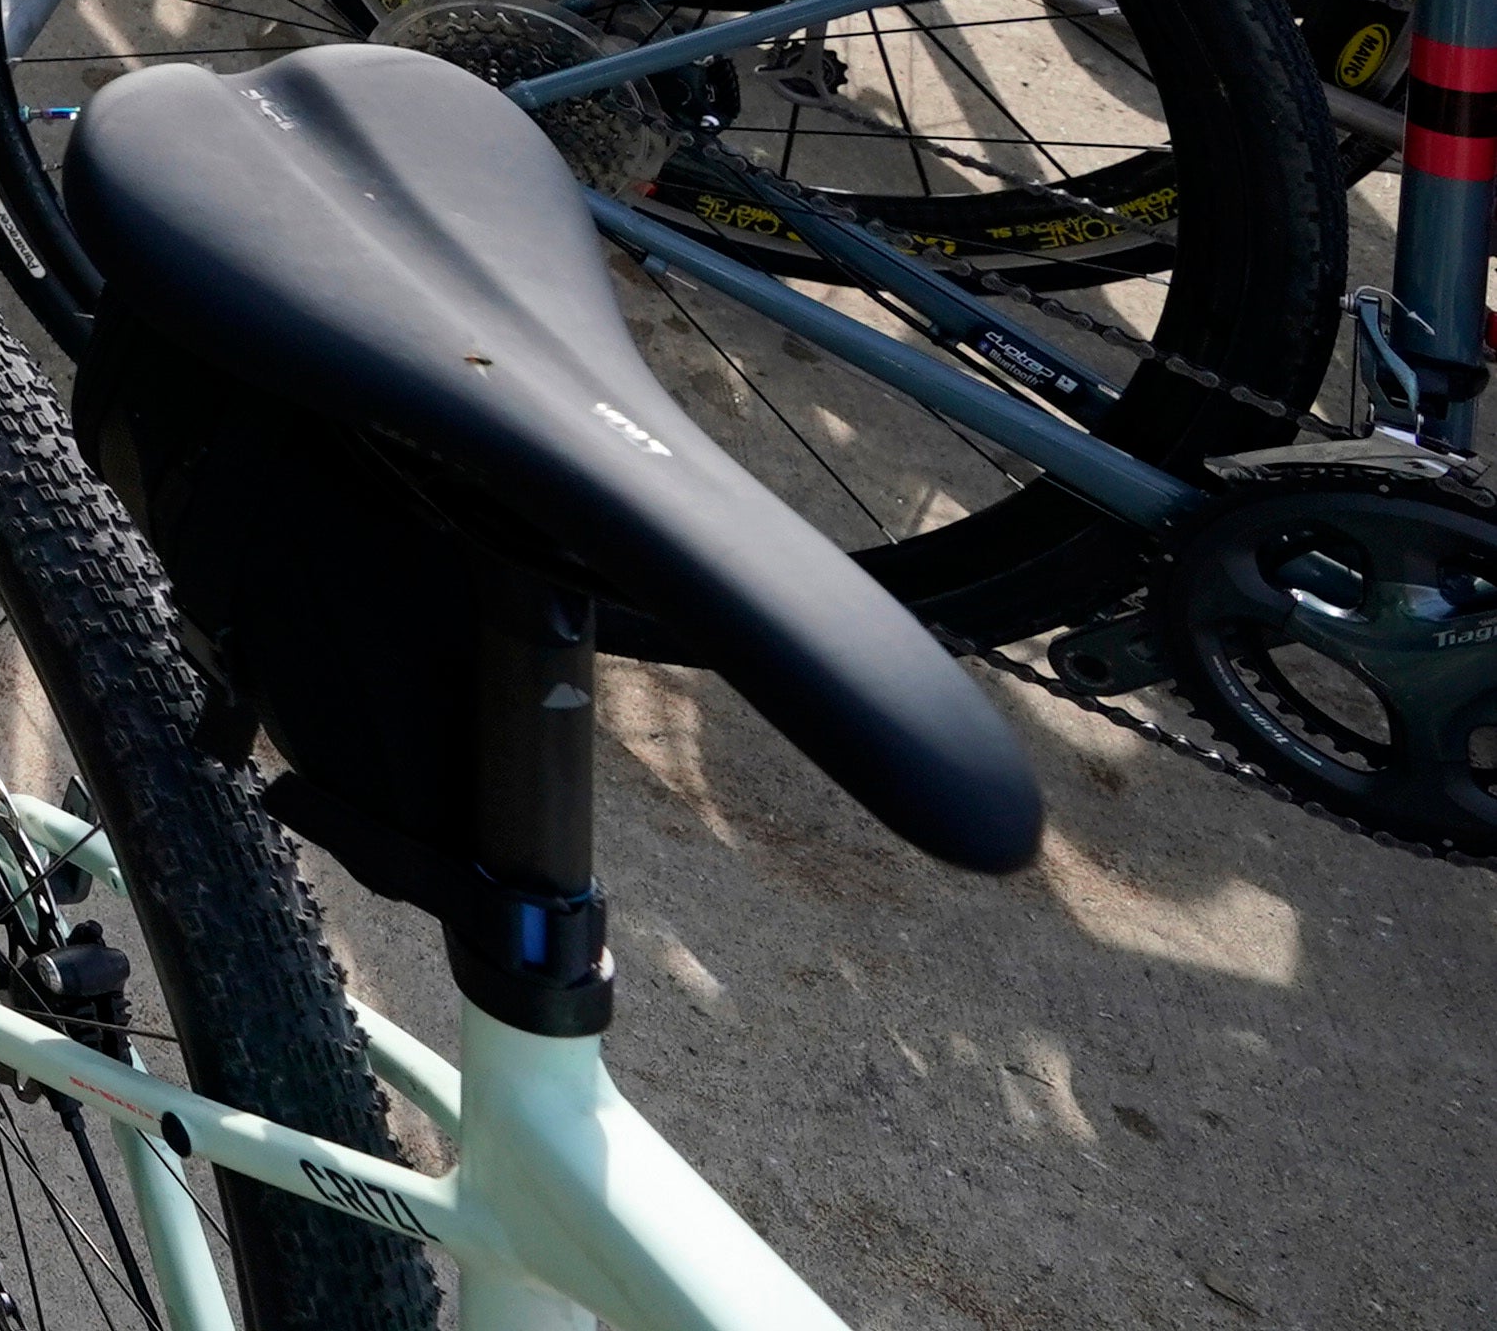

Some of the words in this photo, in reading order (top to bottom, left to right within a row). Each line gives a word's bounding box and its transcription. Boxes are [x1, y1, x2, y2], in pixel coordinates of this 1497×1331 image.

[1343, 33, 1380, 79] MAVIC
[989, 347, 1040, 387] Bluetooth
[1433, 626, 1497, 648] Tiag
[299, 1157, 442, 1246] GRIZL
